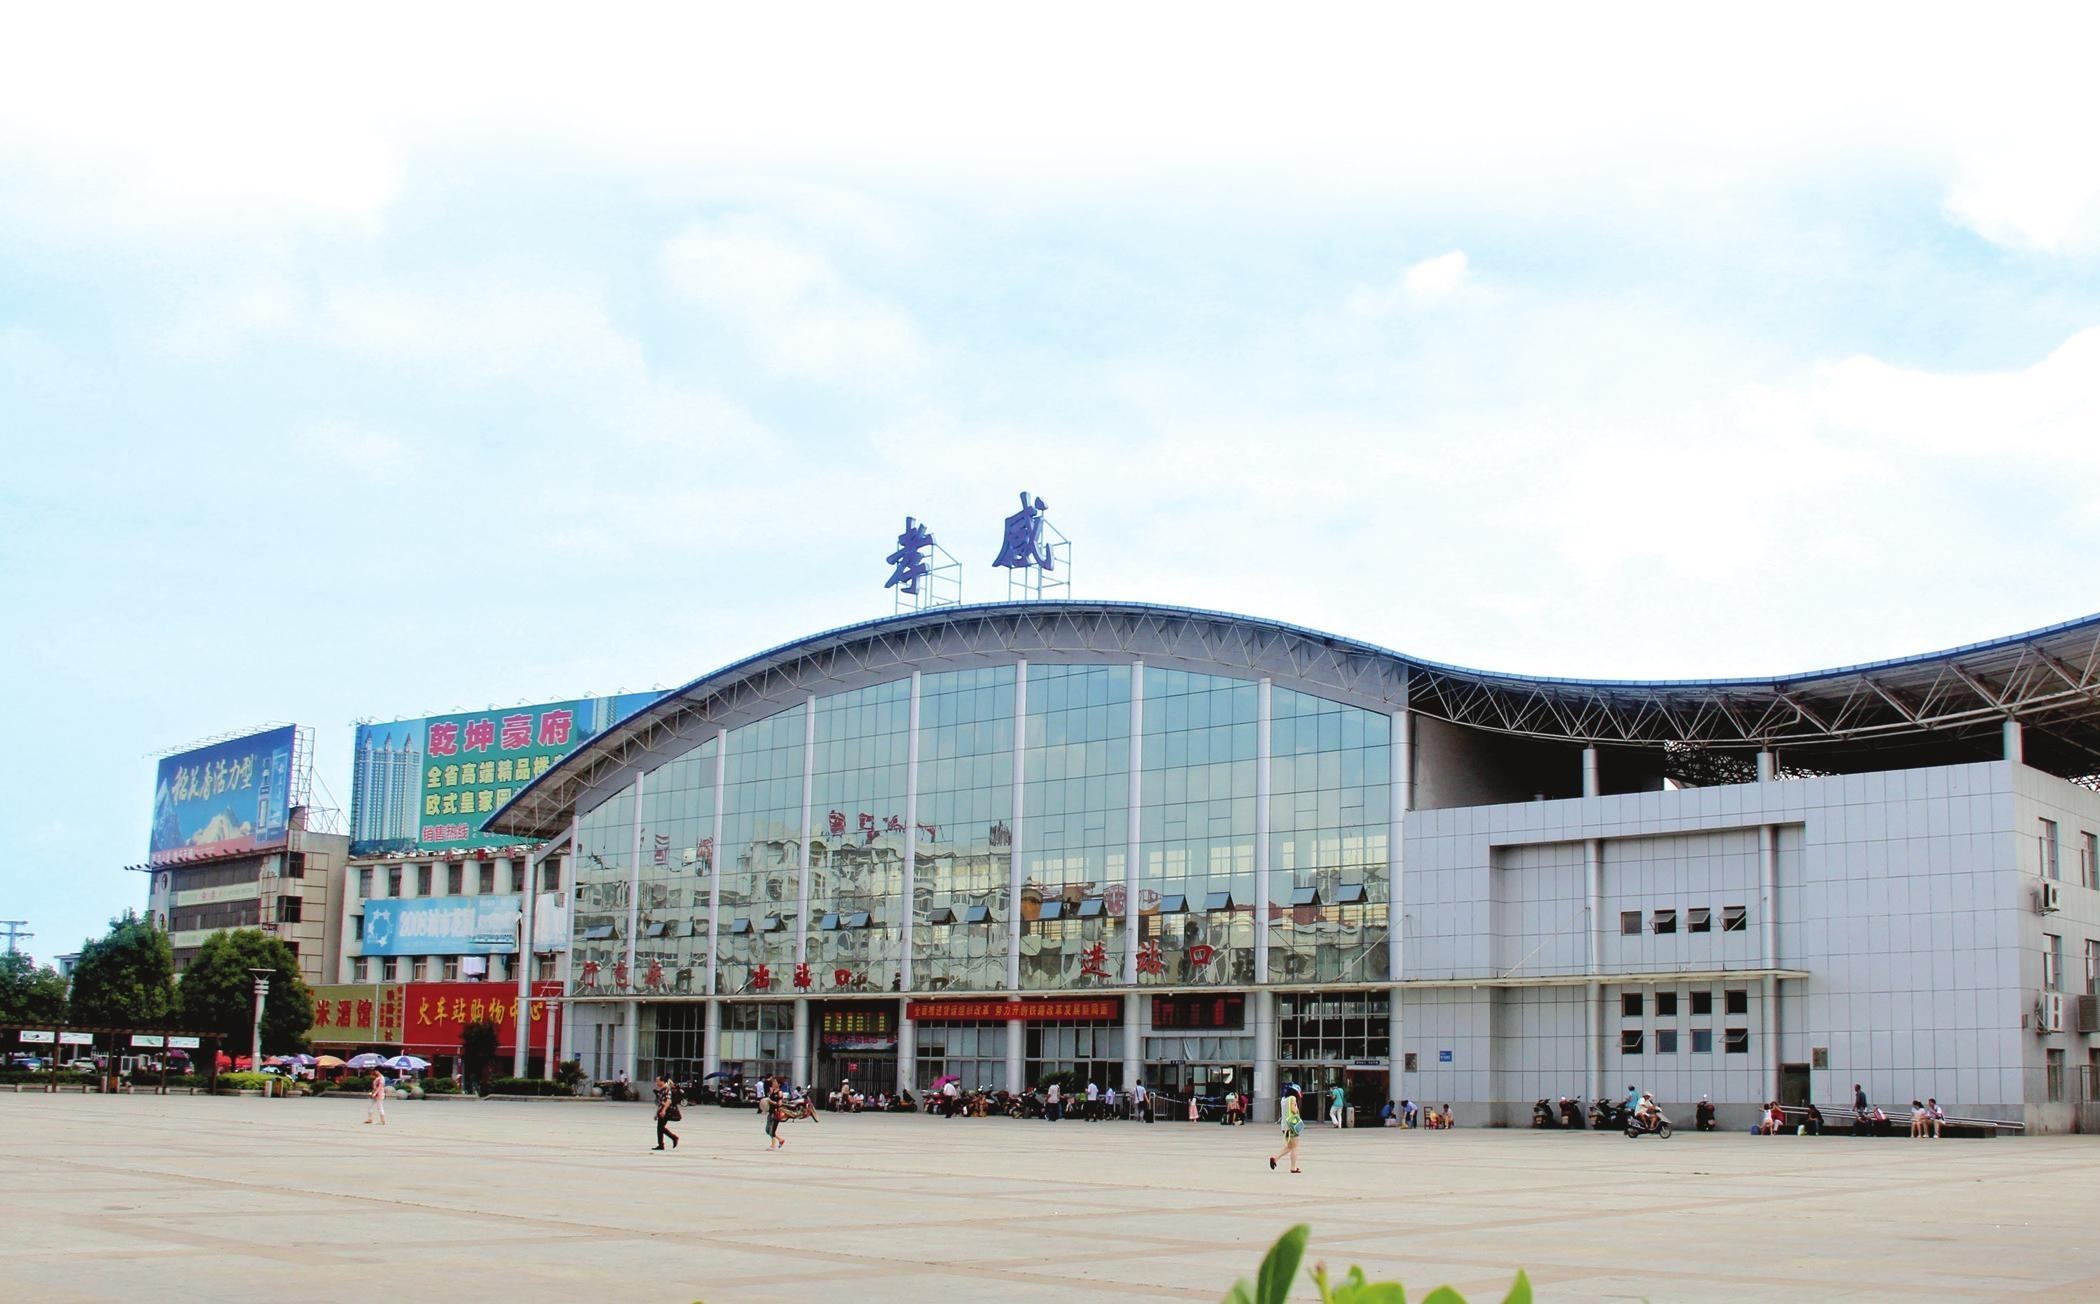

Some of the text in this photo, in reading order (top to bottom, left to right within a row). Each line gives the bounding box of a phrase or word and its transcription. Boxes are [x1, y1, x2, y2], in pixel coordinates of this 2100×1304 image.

[884, 491, 1055, 595] 孝感
[428, 709, 573, 757] 乾坤豪府
[427, 754, 565, 789] 全省高端精品楼
[425, 787, 522, 816] 欧式皇家园
[1081, 939, 1216, 977] 进站口
[752, 963, 852, 989] 出站口
[315, 999, 373, 1028] 米酒馆
[417, 997, 544, 1029] 火车站购物中心
